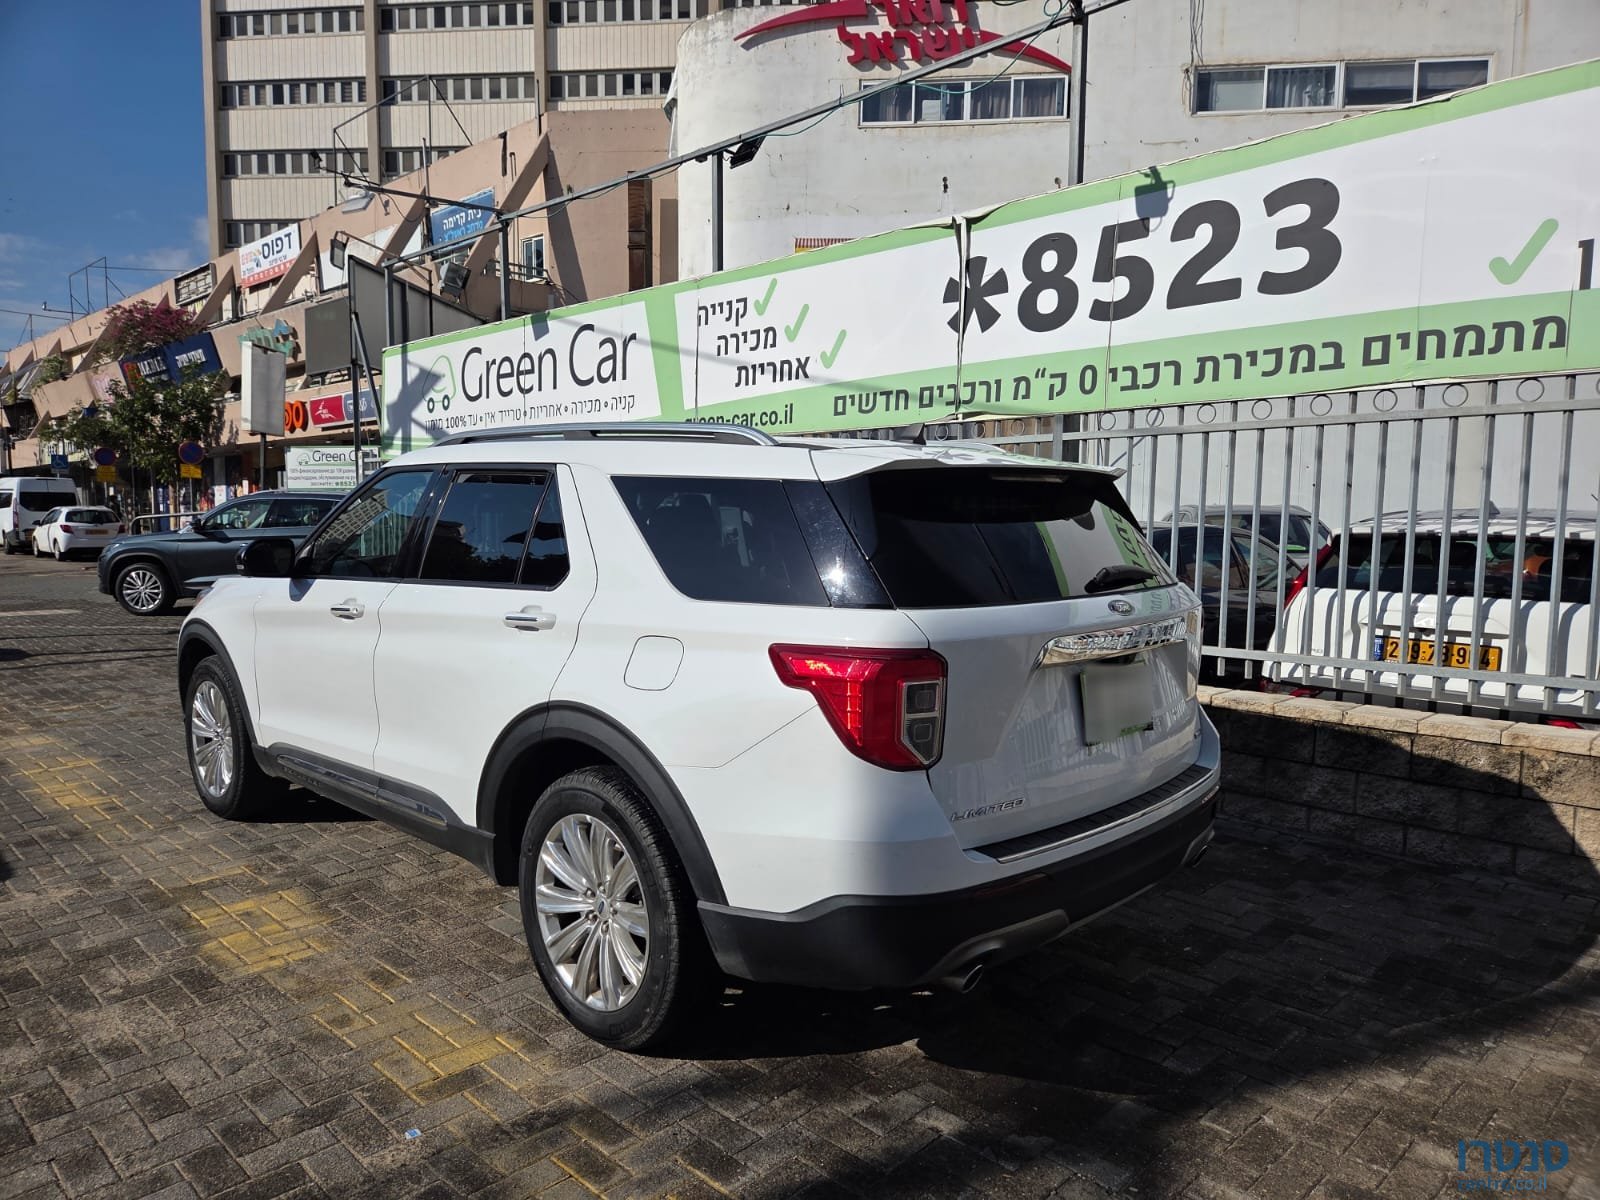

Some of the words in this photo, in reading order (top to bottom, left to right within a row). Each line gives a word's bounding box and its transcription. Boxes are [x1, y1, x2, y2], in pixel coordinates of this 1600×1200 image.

[837, 25, 976, 65] ישראל
[262, 232, 292, 259] דפוס
[698, 297, 748, 327] קנייה
[717, 326, 777, 356] מכירה
[1362, 315, 1567, 366] מתמחים
[461, 347, 557, 402] Green
[569, 324, 637, 386] Car
[735, 356, 811, 388] אחריות
[1109, 360, 1182, 391] רכבי
[1194, 341, 1346, 384] במכירת
[1079, 364, 1098, 395] 0
[571, 399, 601, 415] מכירה
[611, 394, 635, 411] קניה
[833, 389, 910, 417] חדשים
[919, 378, 1002, 409] ורכבים
[446, 415, 467, 430] 100%
[467, 413, 478, 427] עד
[484, 411, 496, 428] אין
[499, 407, 522, 422] טרייד
[529, 403, 562, 420] אחריות
[685, 403, 794, 427] n-car.co.il
[312, 450, 346, 462] Green
[951, 798, 1025, 821] LIMITED
